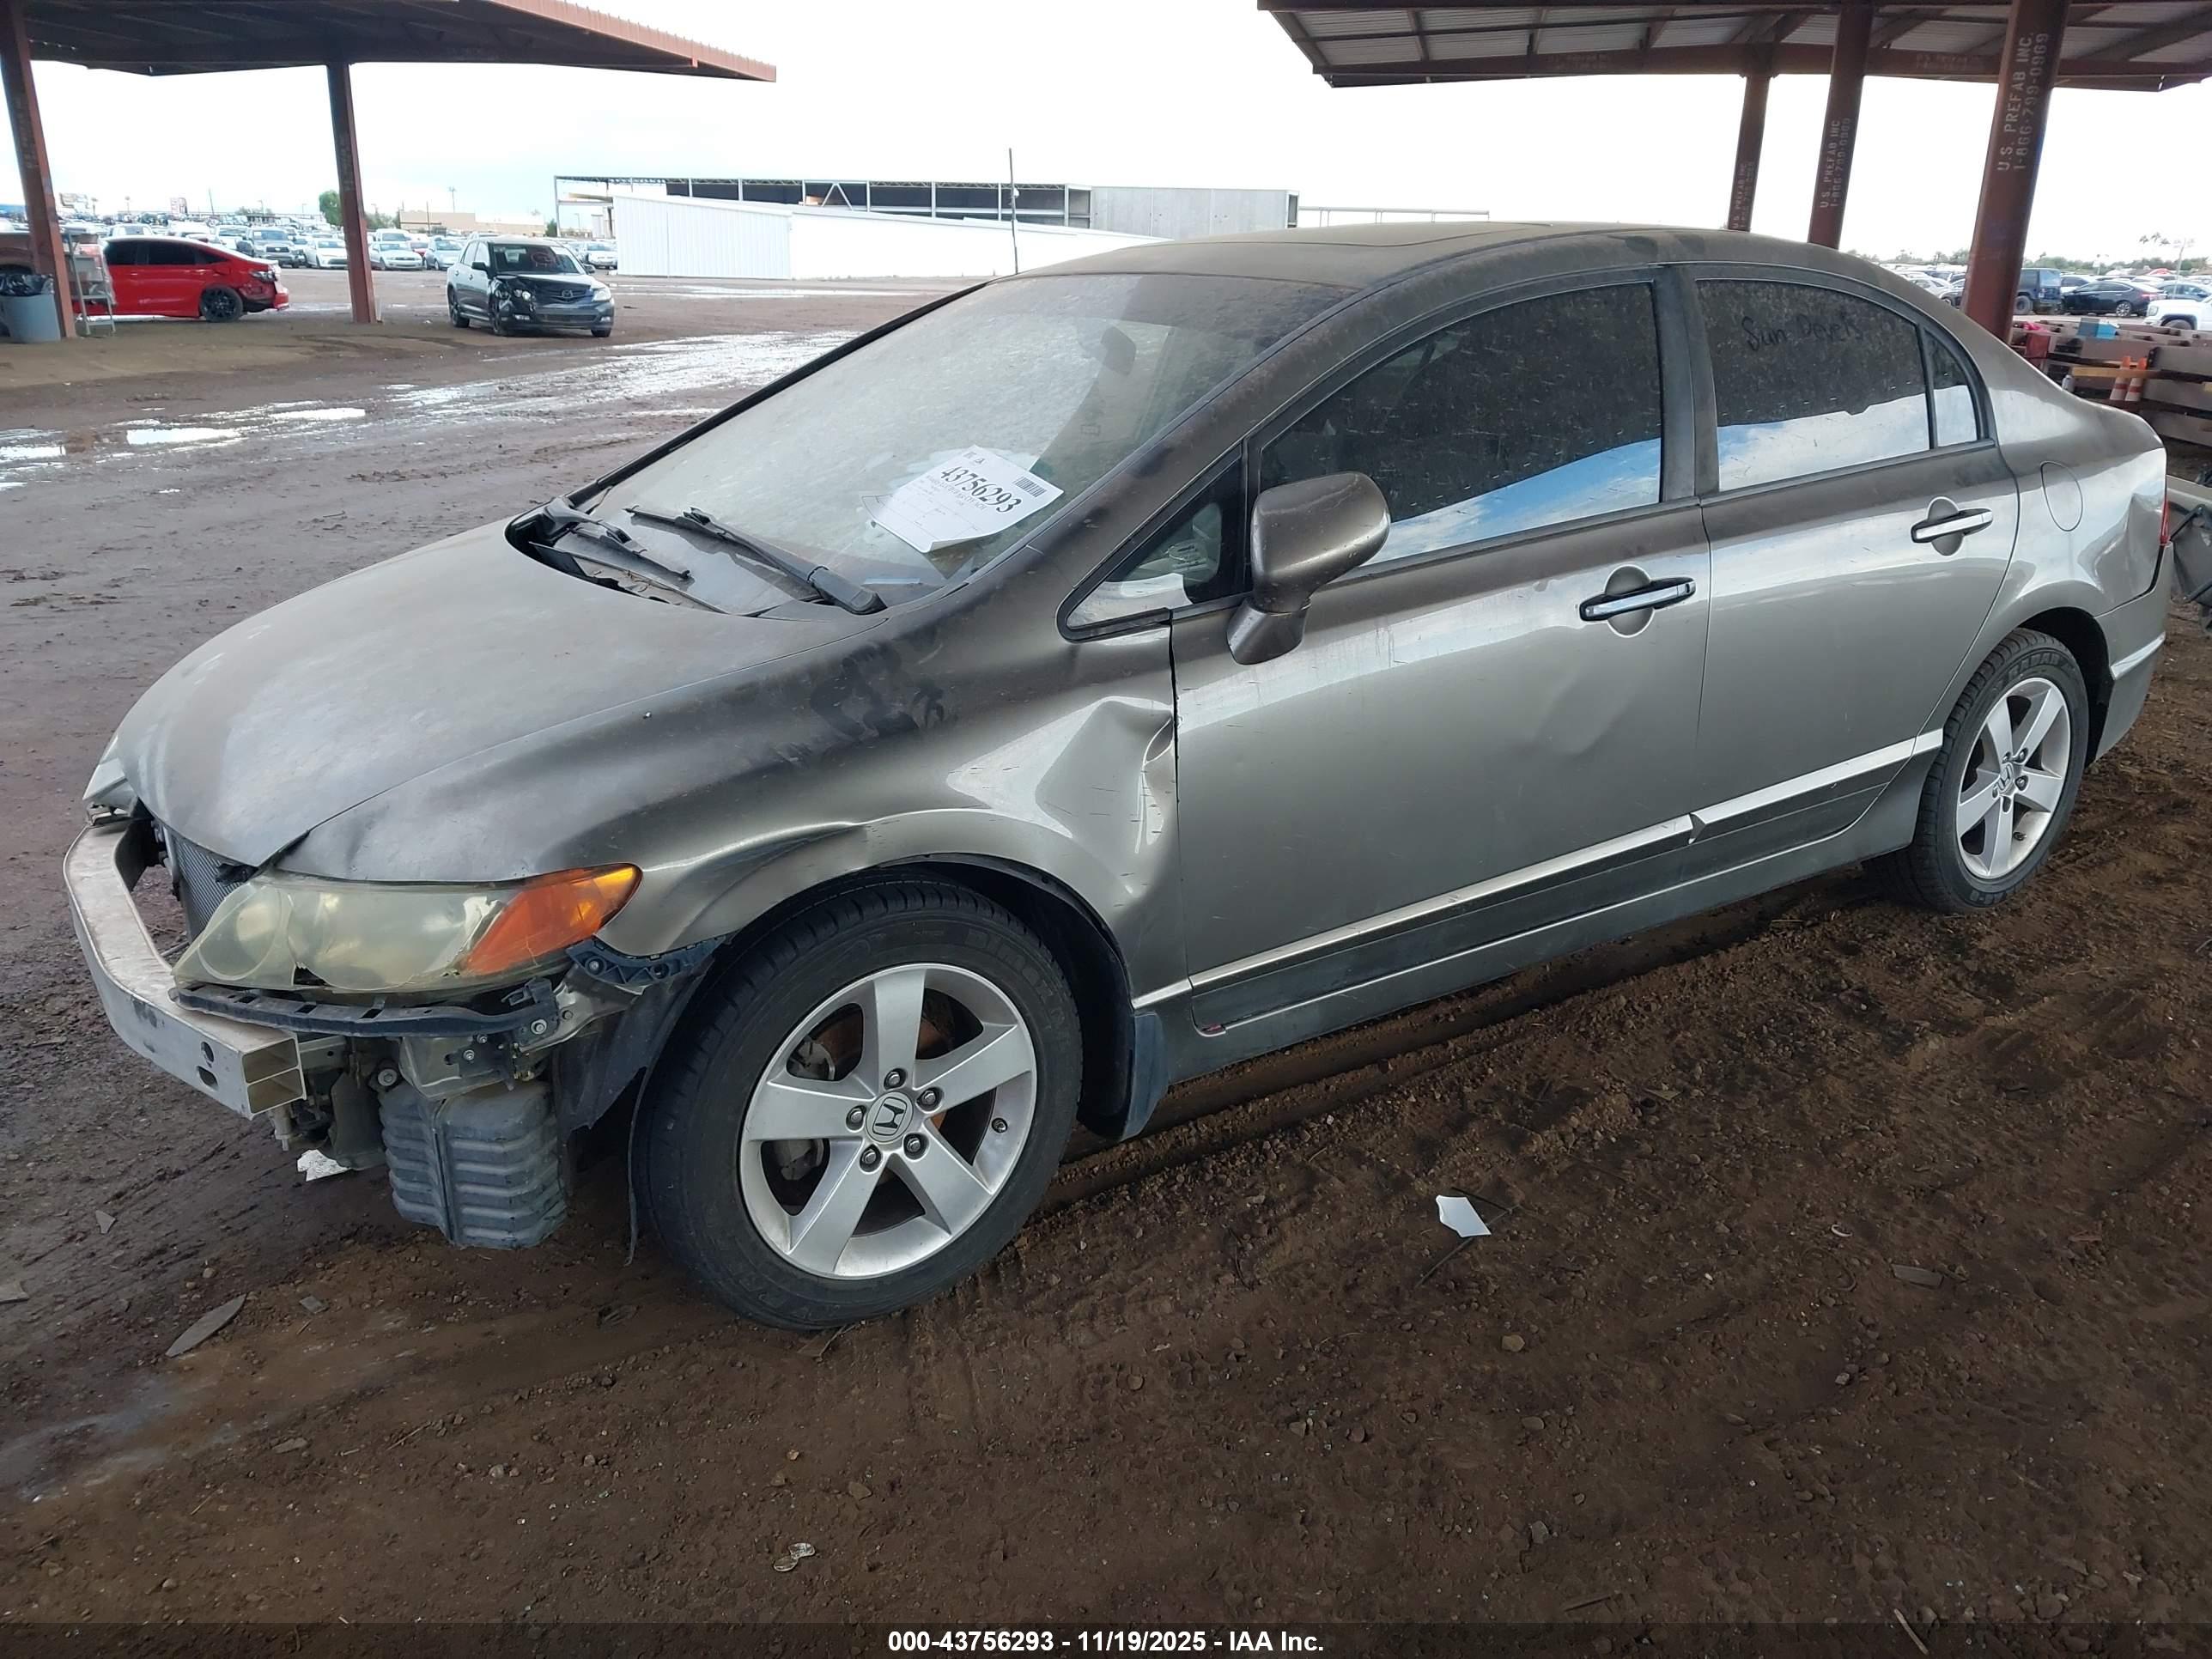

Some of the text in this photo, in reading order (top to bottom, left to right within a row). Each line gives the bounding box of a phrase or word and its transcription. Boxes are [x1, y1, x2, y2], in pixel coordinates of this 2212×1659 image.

[2004, 71, 2026, 132] PREFAB
[1997, 142, 2014, 171] U.S.
[1741, 315, 1788, 351] Sun
[940, 466, 1022, 513] 43756293
